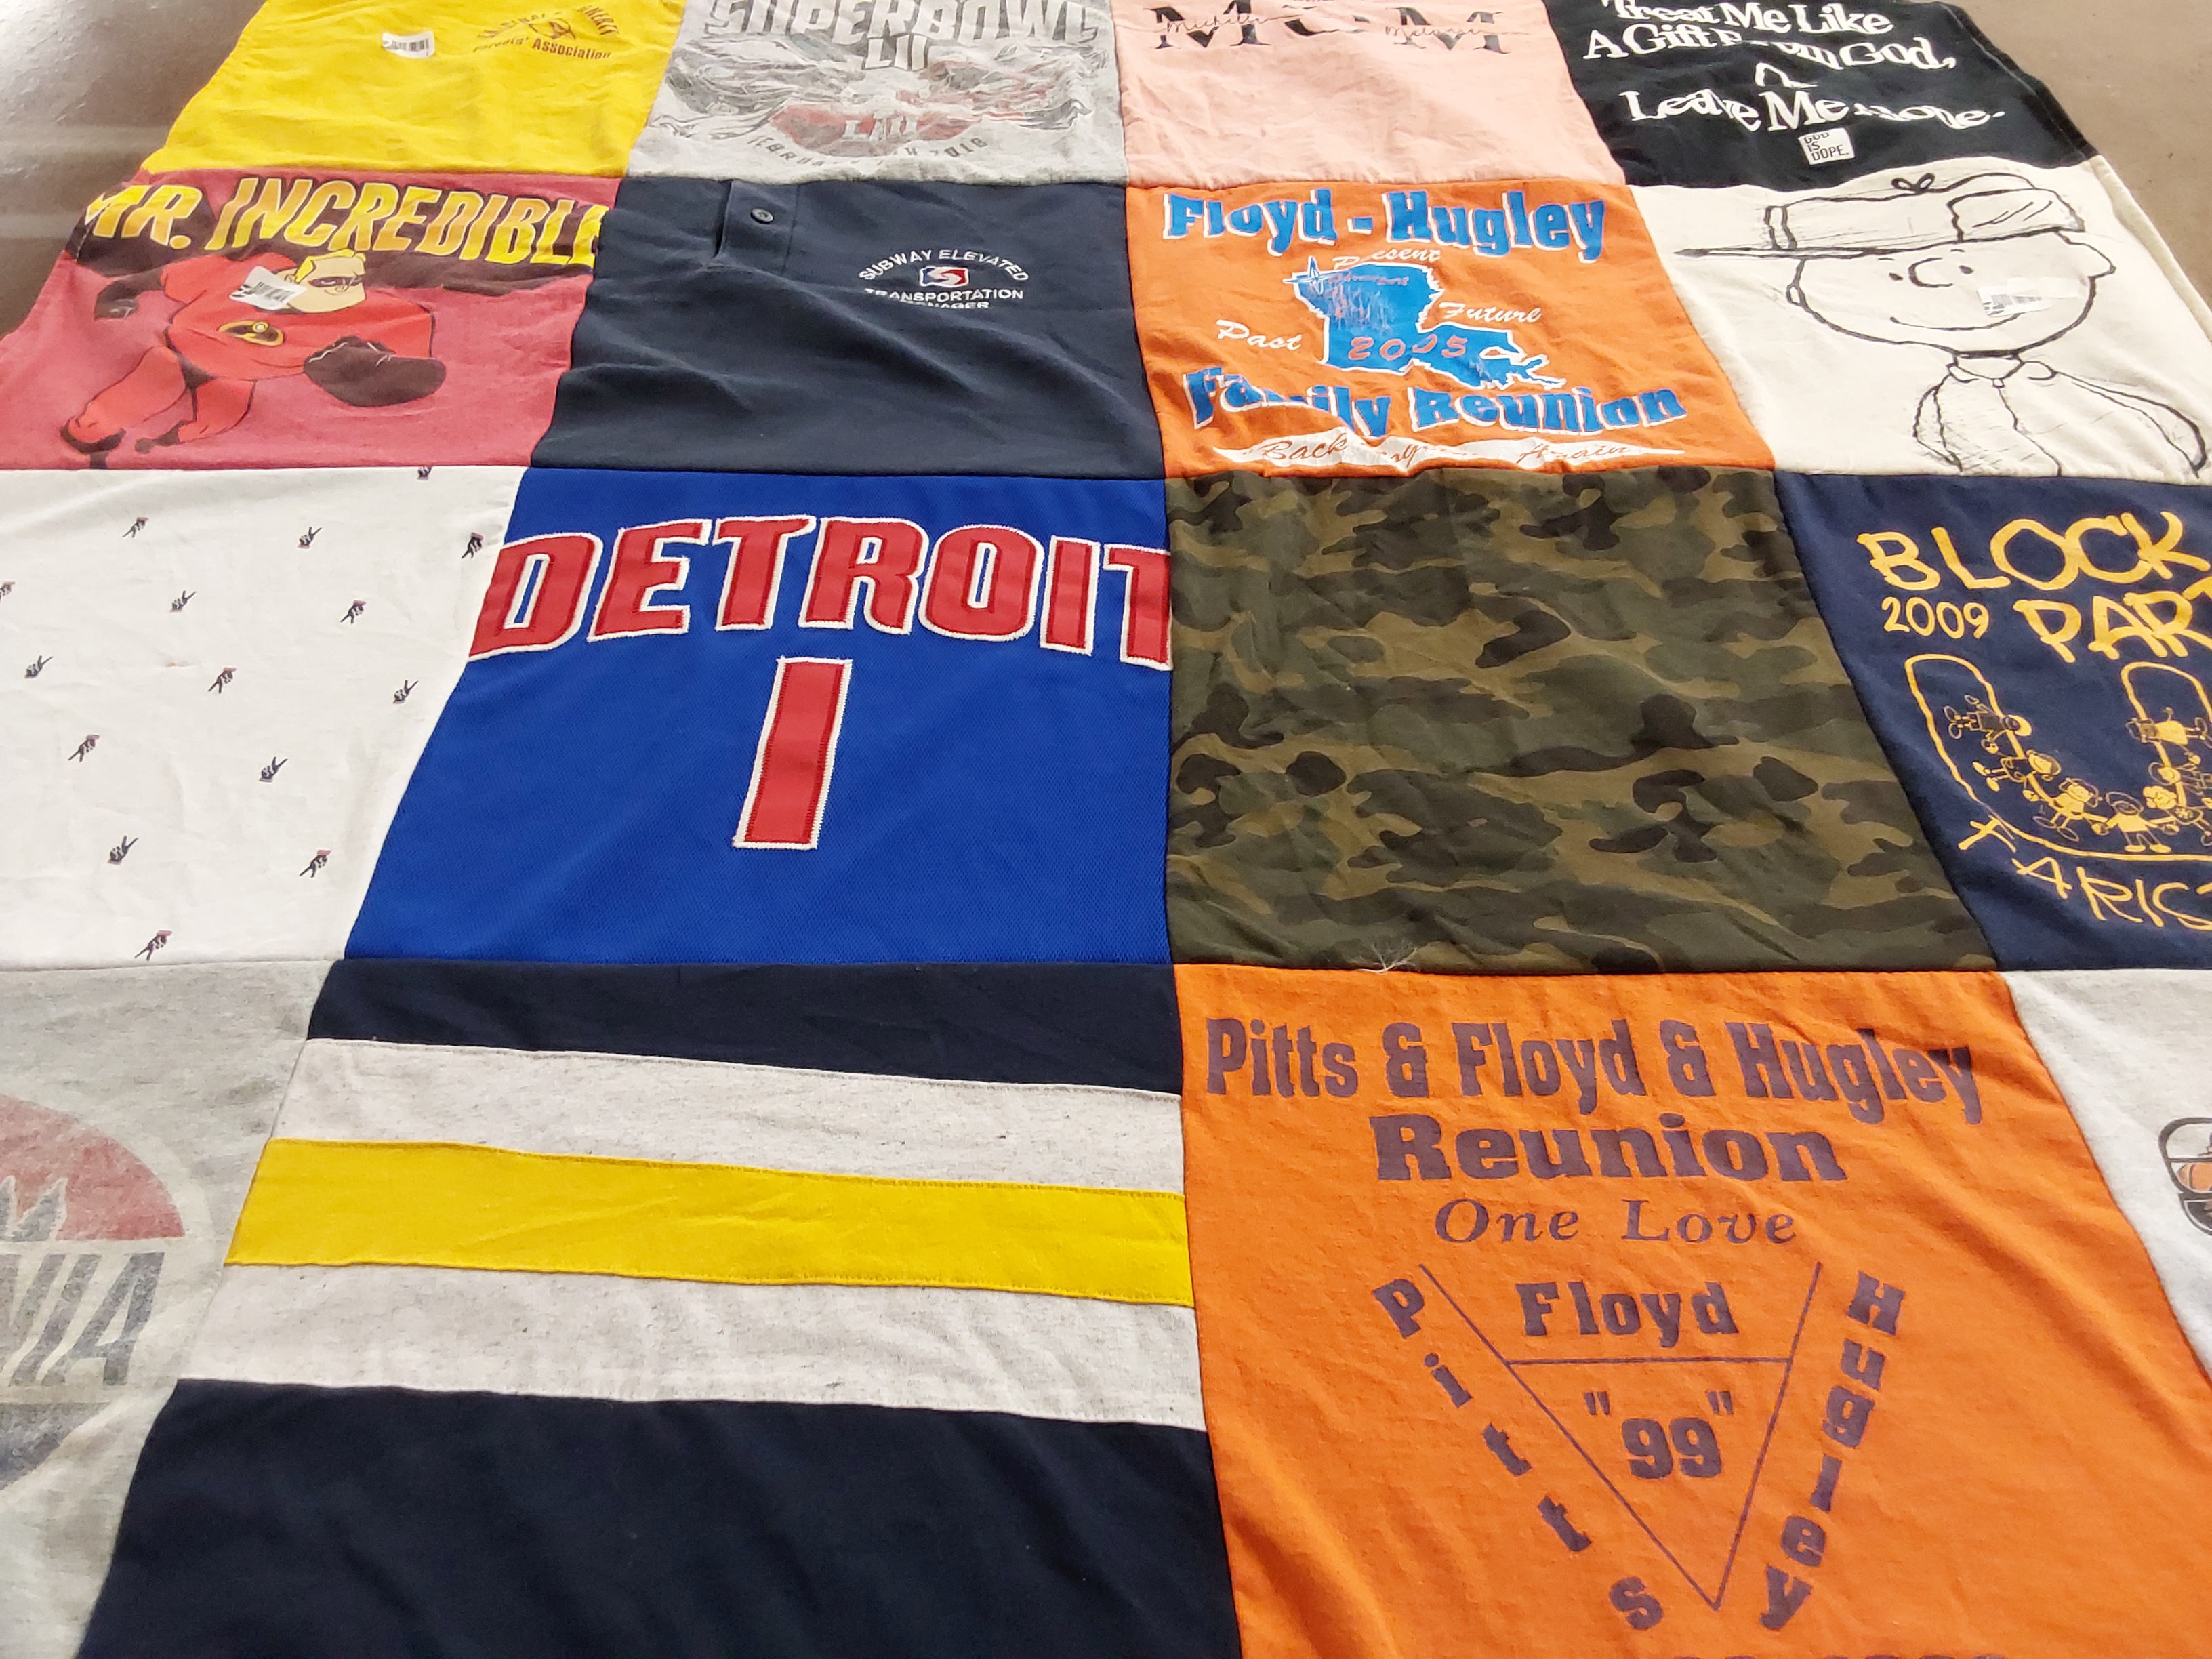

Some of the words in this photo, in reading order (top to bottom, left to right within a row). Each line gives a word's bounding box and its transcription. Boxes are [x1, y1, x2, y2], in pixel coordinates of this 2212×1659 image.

[1714, 2, 1791, 33] Me
[1788, 3, 1893, 35] Like
[532, 38, 611, 60] Association
[1583, 30, 1629, 59] A
[1623, 24, 1717, 54] Gift
[1710, 28, 1843, 70] Fm
[1839, 37, 1957, 70] God,
[1618, 89, 1761, 131] Leave
[1759, 91, 1849, 131] Me
[1808, 141, 1821, 152] IS
[1811, 145, 1849, 161] DOPE.
[1163, 188, 1339, 256] Floyd
[1382, 190, 1605, 264] Hugley
[859, 249, 932, 280] SUBWAY
[938, 249, 1029, 281] ELEVATED
[1332, 249, 1441, 270] Pesent
[1439, 302, 1542, 323] Future
[1216, 319, 1303, 350] Past
[1408, 386, 1687, 436] Reunion
[1260, 432, 1348, 460] Back
[1517, 444, 1631, 464] Aain
[1856, 512, 2211, 590] BLOCK
[1881, 596, 1990, 639] 2009
[733, 657, 852, 849] 1
[1204, 1017, 1358, 1098] Pitts
[1381, 1021, 1435, 1098] &
[1451, 1019, 1647, 1118] Floyd
[1658, 1019, 1717, 1099] &
[1726, 1021, 1984, 1126] Hugley
[1368, 1113, 1848, 1182] Reunion
[1434, 1197, 1580, 1244] One
[1620, 1197, 1797, 1244] Love
[1515, 1281, 1740, 1349] Floyd
